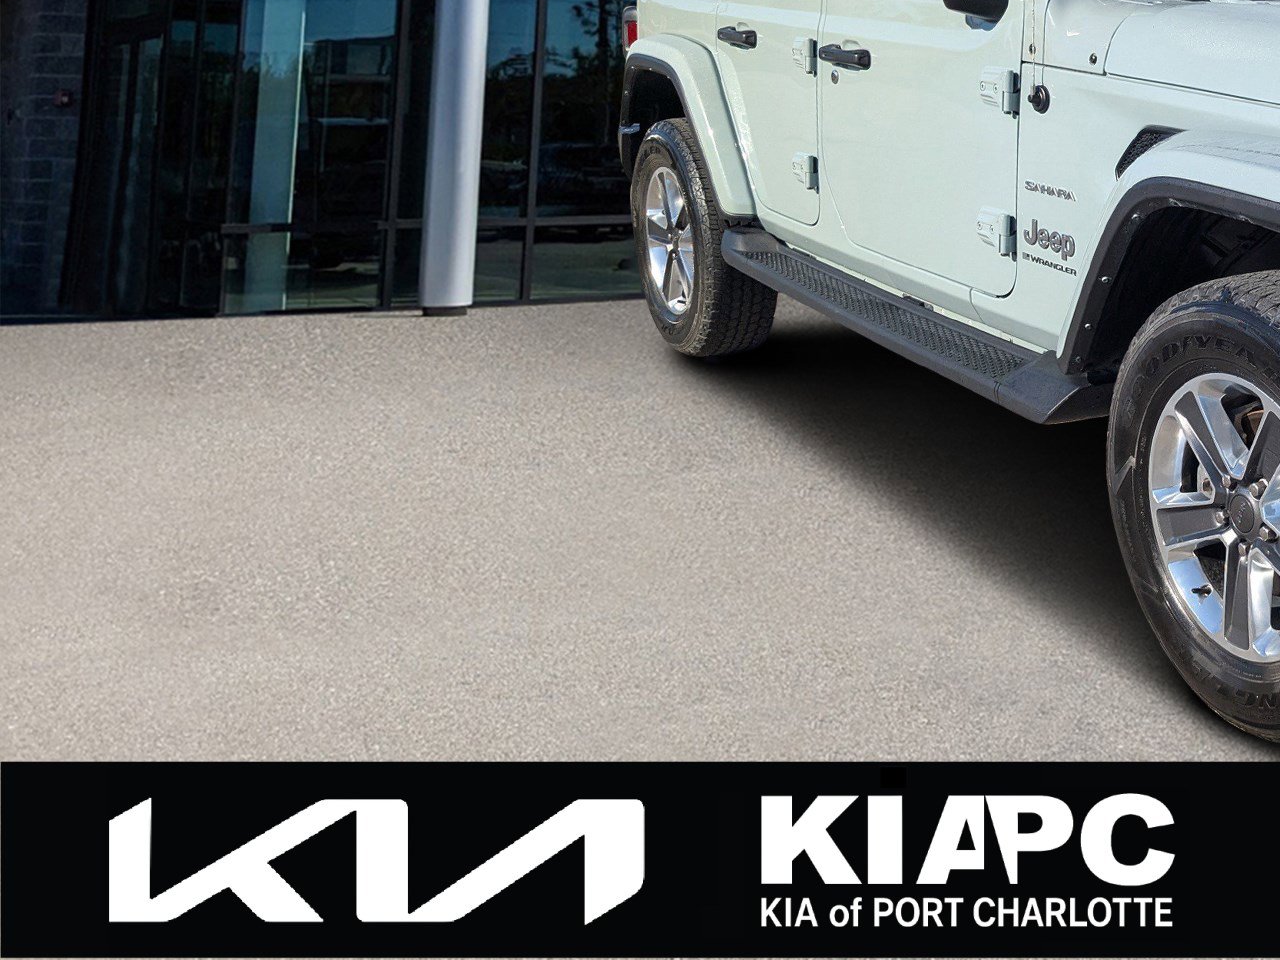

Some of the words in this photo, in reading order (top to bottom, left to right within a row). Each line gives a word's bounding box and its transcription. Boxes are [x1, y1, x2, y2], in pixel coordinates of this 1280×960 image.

[1025, 180, 1077, 202] SAHARA
[1023, 218, 1076, 261] Jeep
[1030, 254, 1077, 277] WRANGLER
